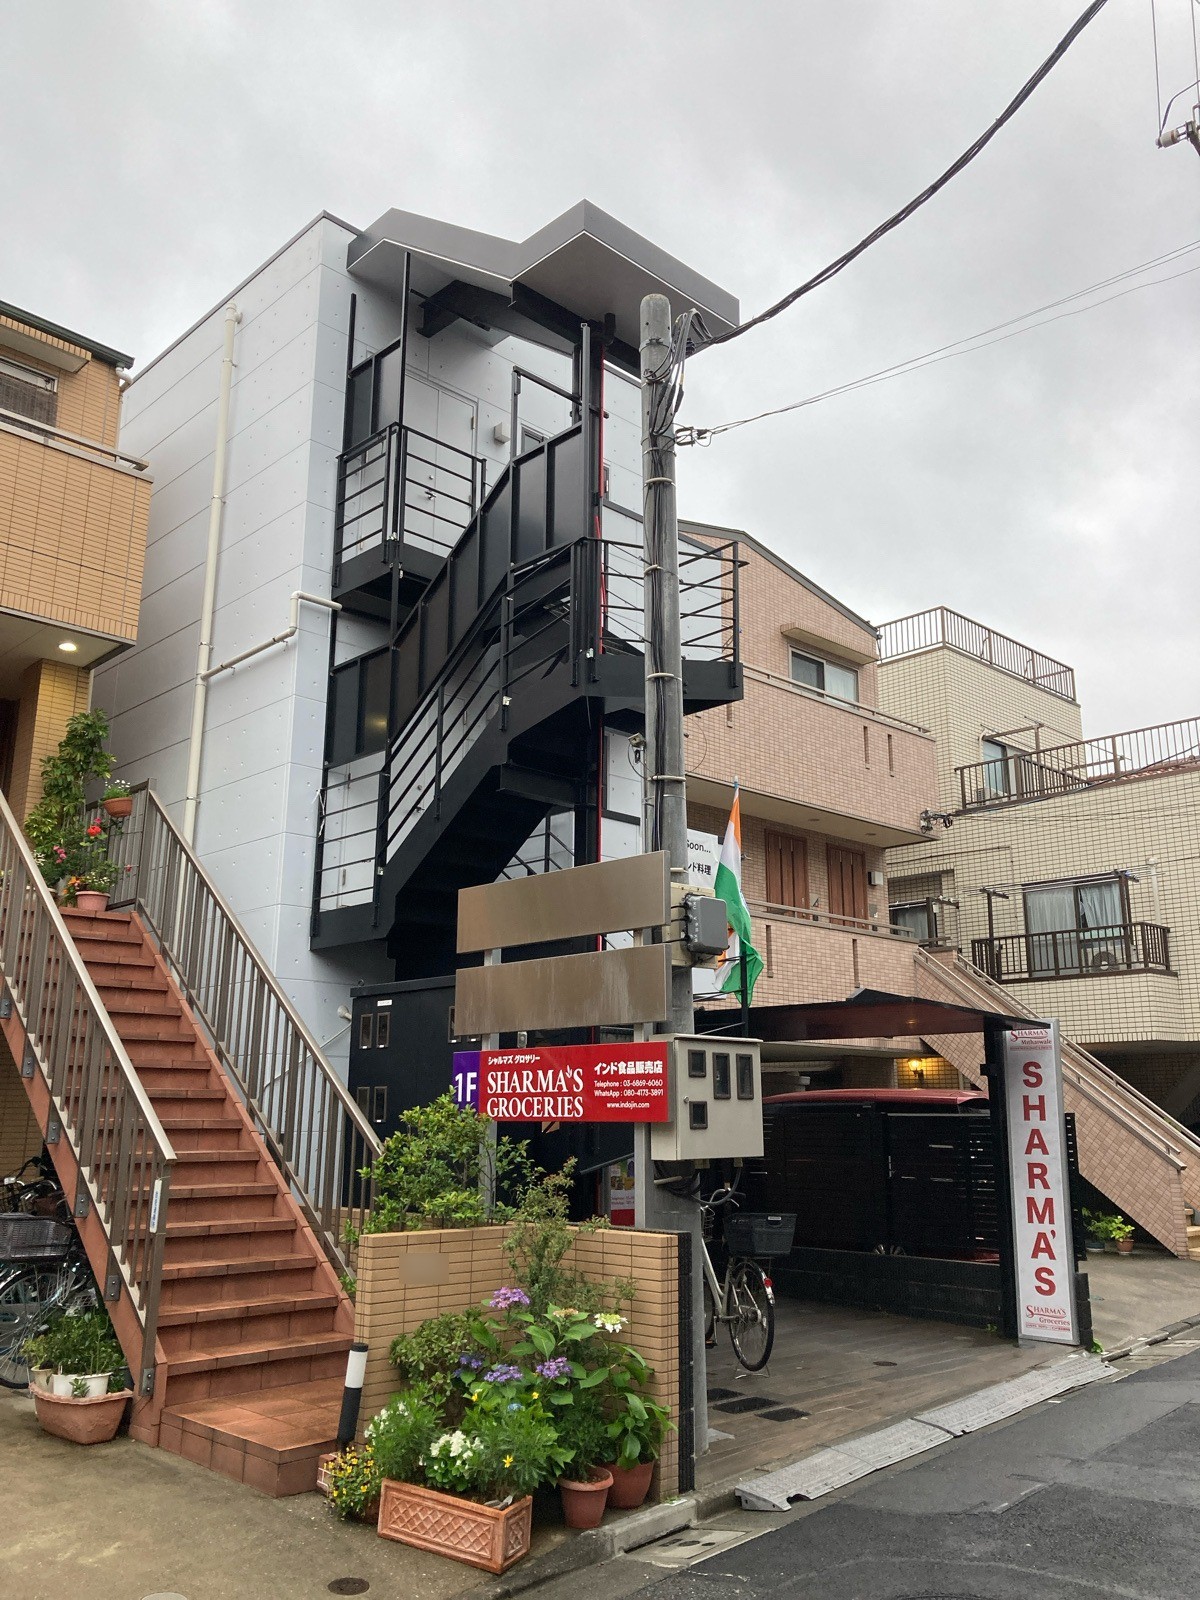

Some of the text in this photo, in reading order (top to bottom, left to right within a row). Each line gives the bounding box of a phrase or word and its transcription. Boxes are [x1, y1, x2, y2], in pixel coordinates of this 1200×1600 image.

[488, 1055, 540, 1065] シャルマズ グロサリー
[594, 1060, 663, 1075] インド食品販売店
[454, 1071, 477, 1102] 1F
[487, 1065, 584, 1094] SHARMA'S
[594, 1080, 619, 1088] Telephone
[623, 1079, 663, 1087] 03-6869-6060
[594, 1089, 619, 1098] WhatsApp
[623, 1088, 664, 1097] 080-4173-3891
[487, 1096, 584, 1118] GROCERIES
[606, 1101, 650, 1109] www.indojin.com
[1022, 1061, 1057, 1296] SHARMA'S
[1026, 1304, 1067, 1318] SHARMA'S
[1039, 1317, 1071, 1326] Groceries
